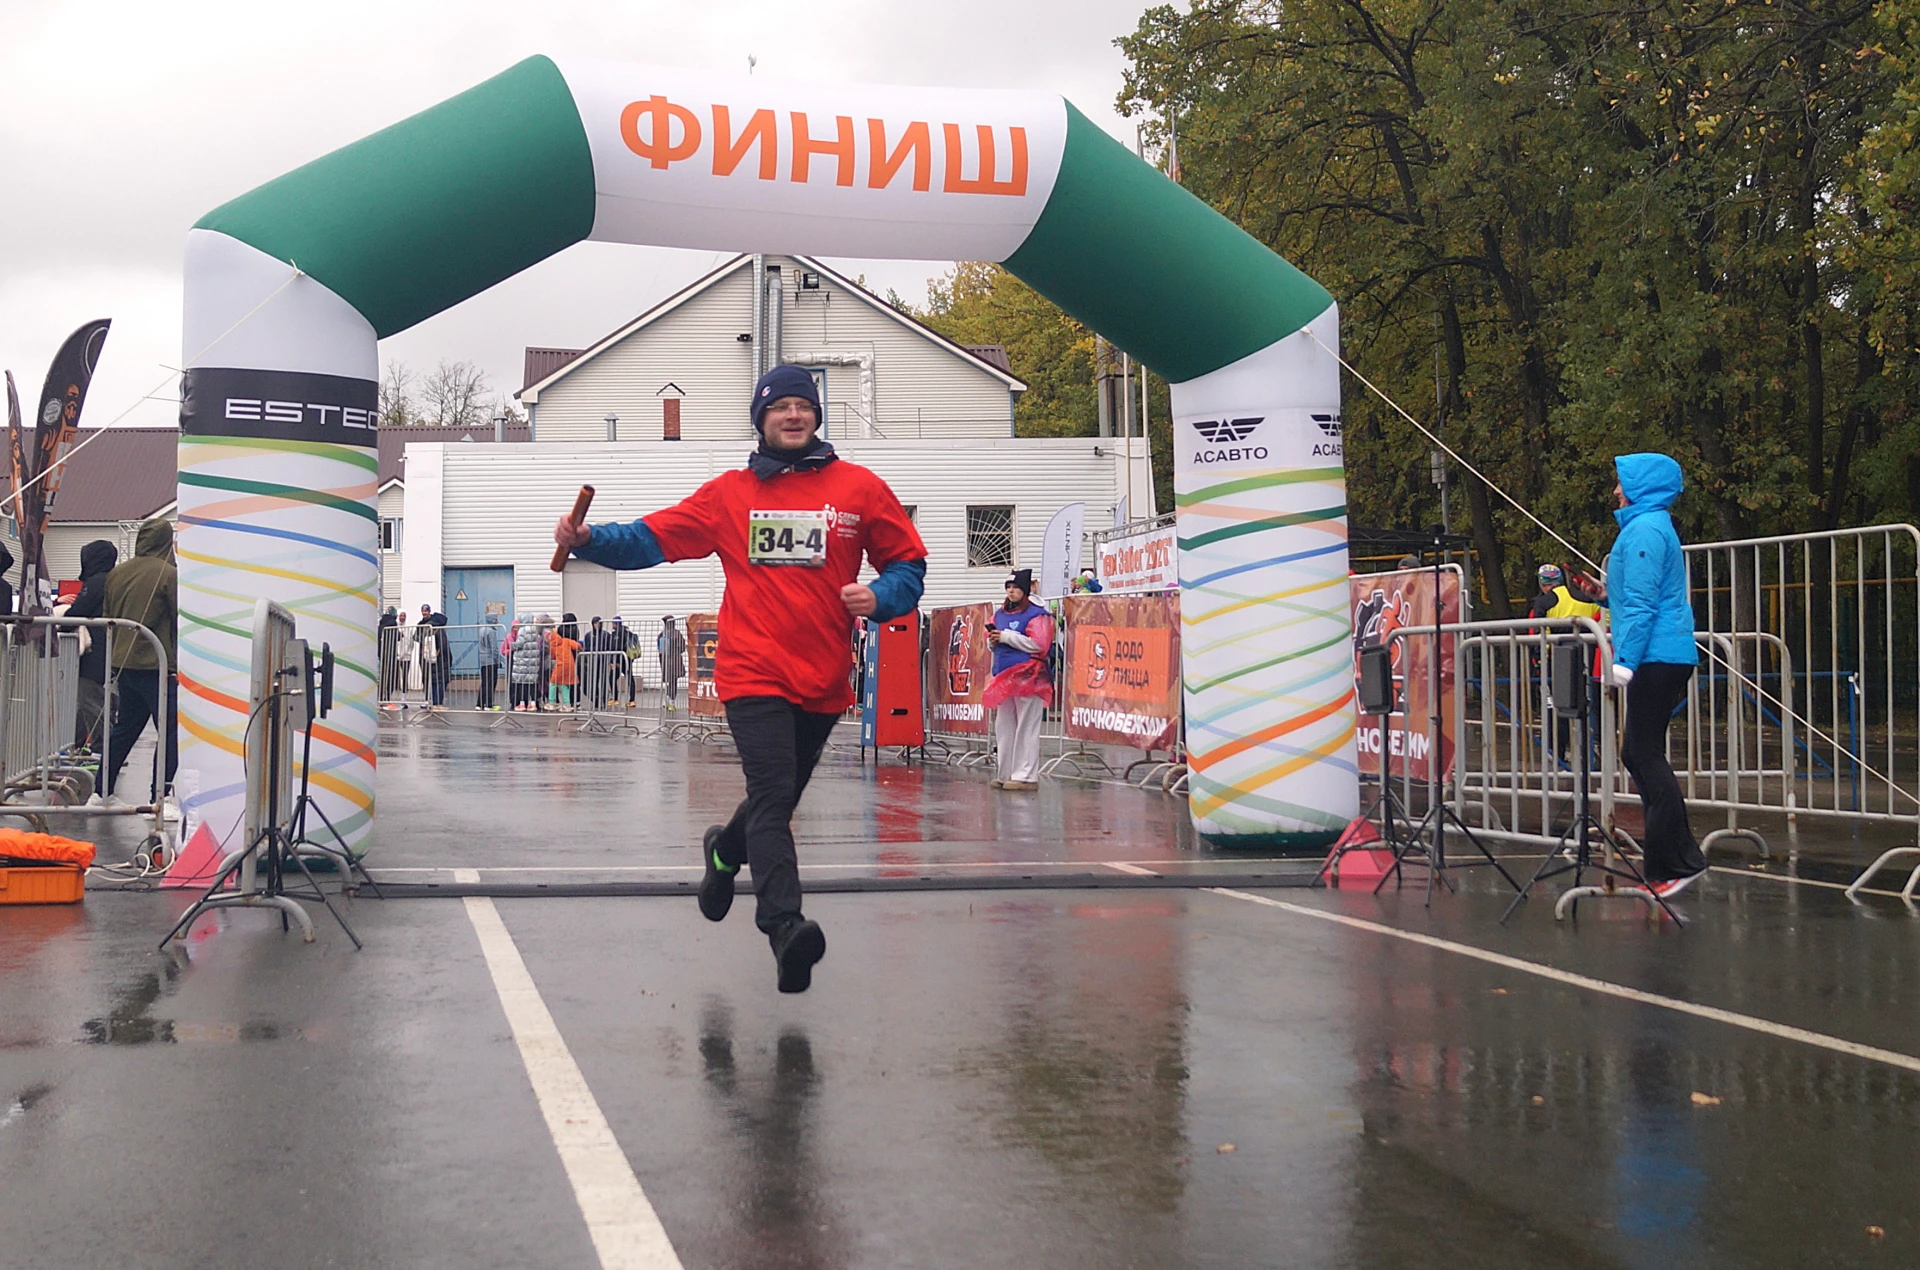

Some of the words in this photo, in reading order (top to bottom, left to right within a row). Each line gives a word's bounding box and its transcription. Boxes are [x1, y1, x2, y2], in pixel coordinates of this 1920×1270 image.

[619, 94, 1029, 197] ФИНИШ
[1193, 446, 1269, 464] АСАВТО
[758, 527, 823, 553] 34-4
[1114, 640, 1144, 662] ДОДО
[1112, 666, 1150, 690] ПИЦЦА
[1071, 706, 1167, 737] #ТОЧНОБЕЖИМ
